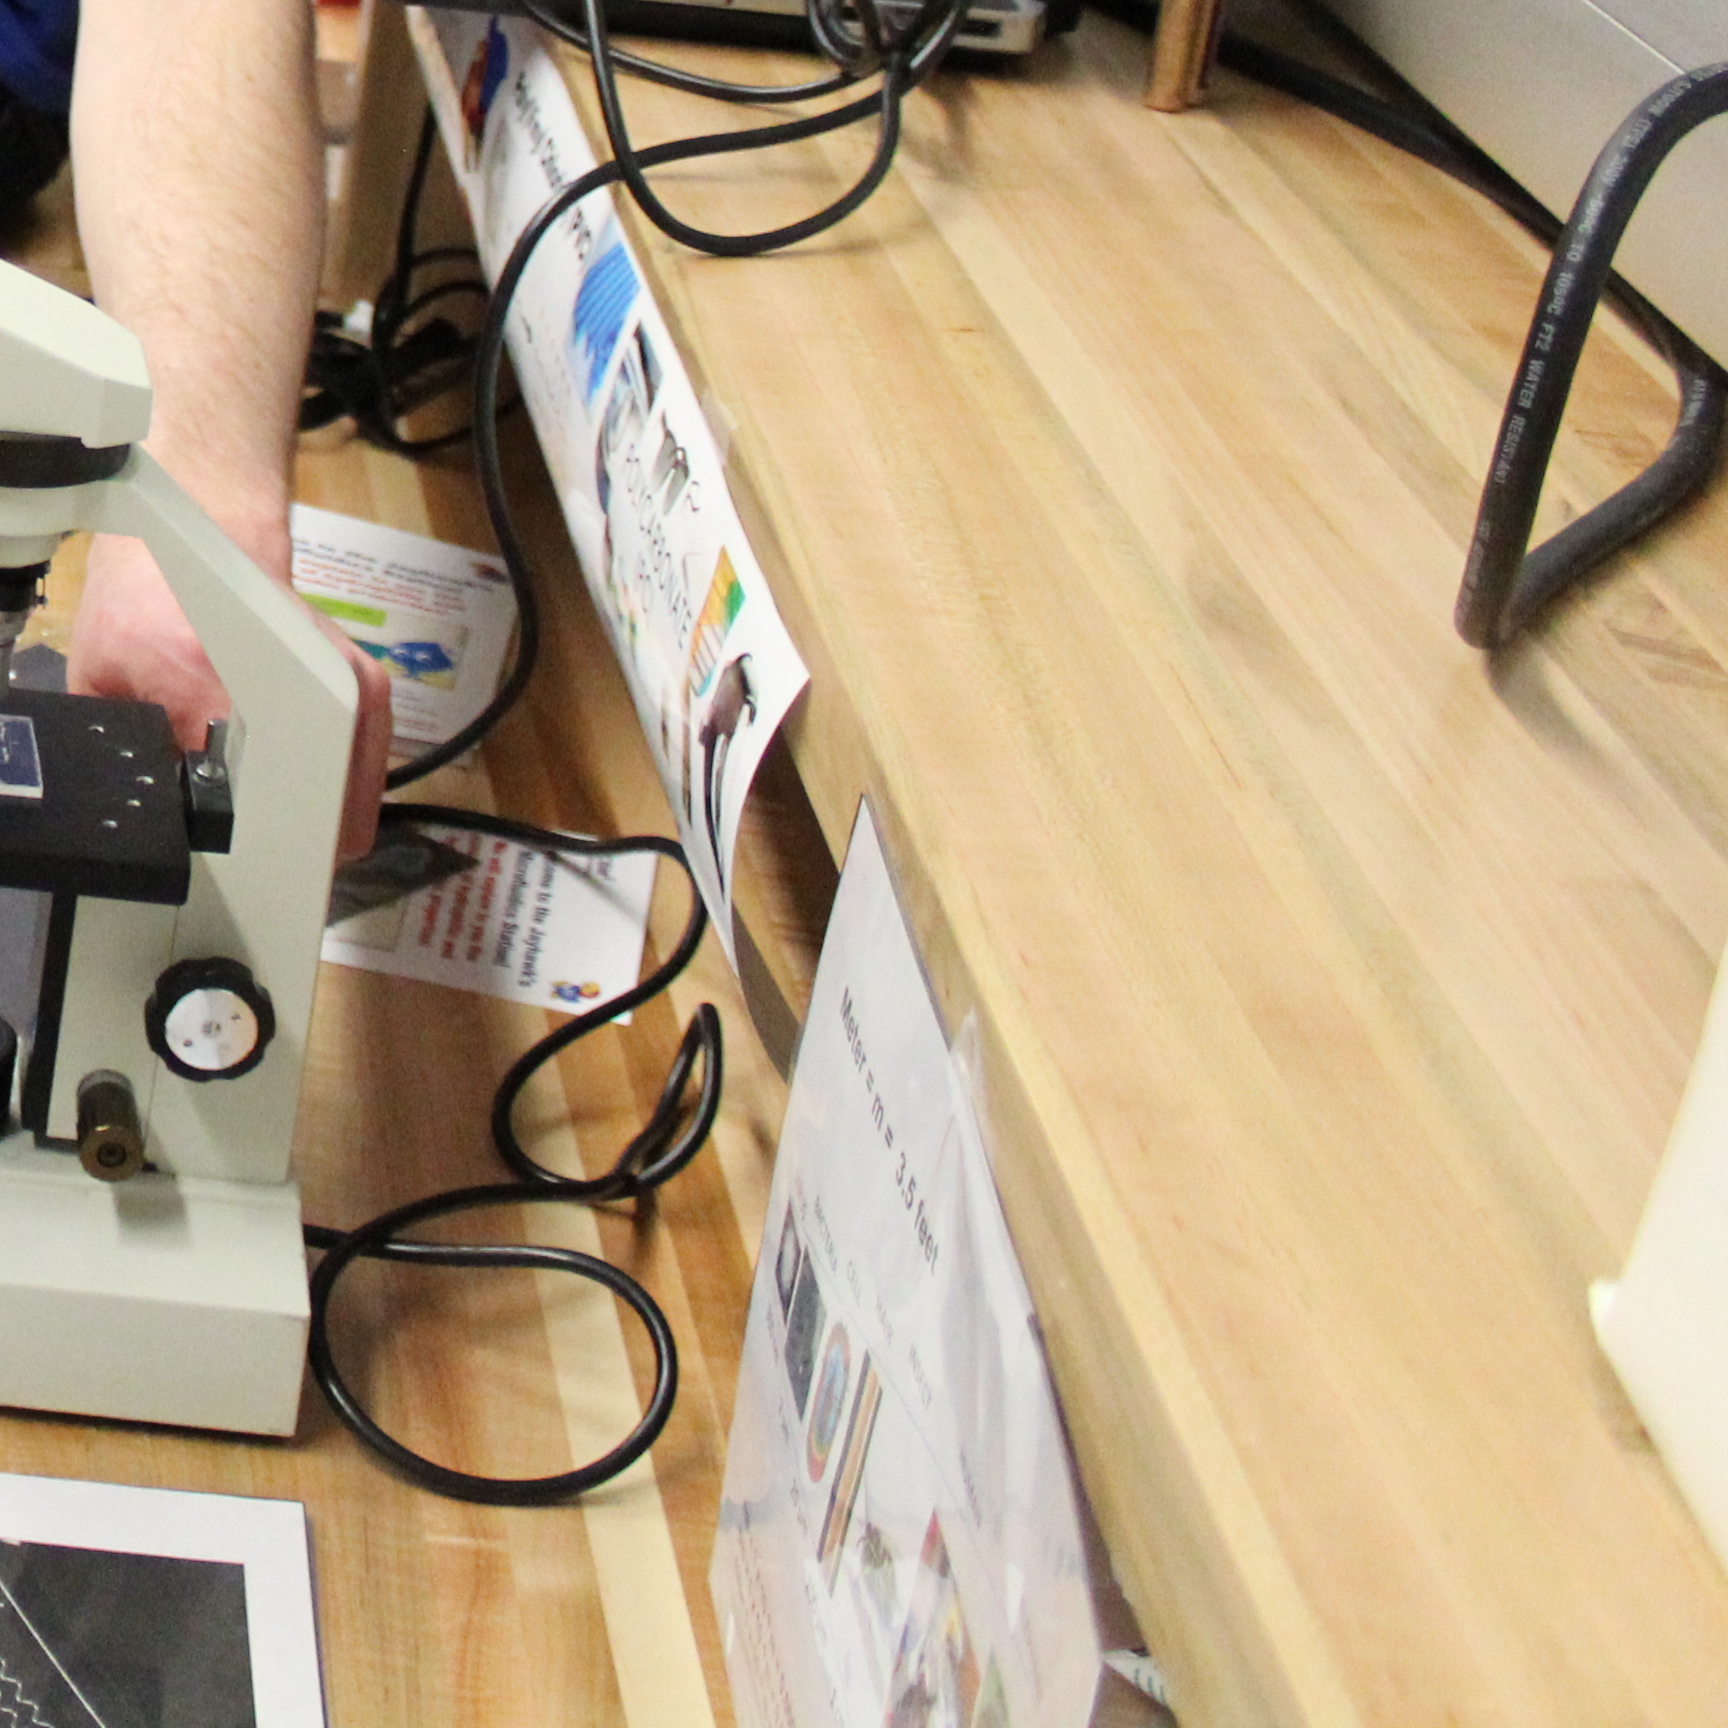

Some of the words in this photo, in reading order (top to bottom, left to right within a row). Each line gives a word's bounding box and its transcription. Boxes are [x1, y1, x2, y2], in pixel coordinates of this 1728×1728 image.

[840, 986, 866, 1073] Meter
[871, 1092, 885, 1132] m
[895, 1150, 917, 1211] 3.5
[913, 1199, 939, 1277] feet
